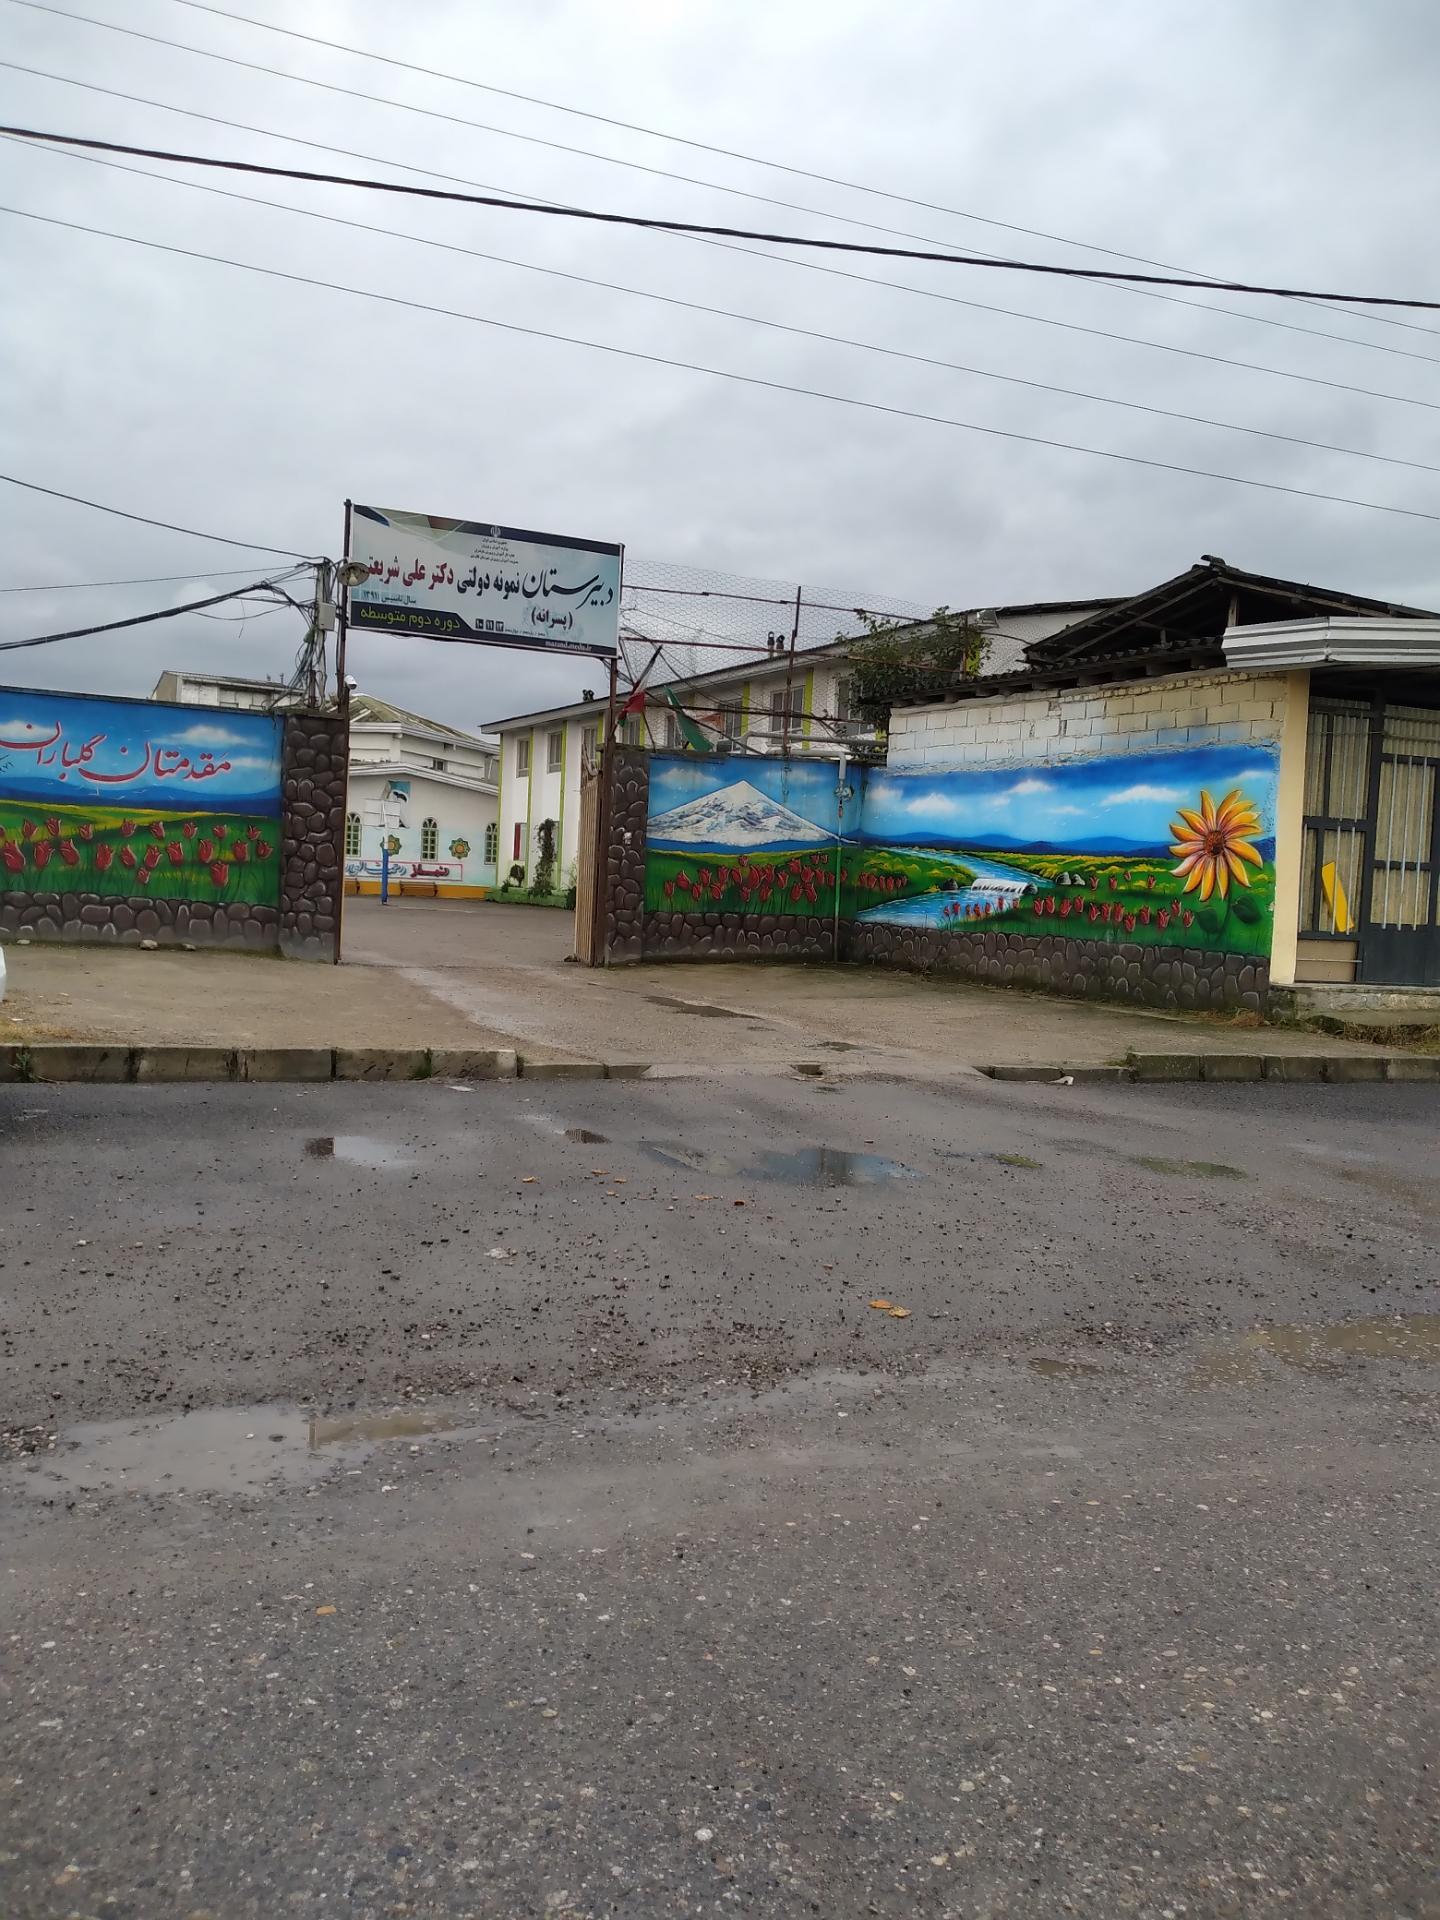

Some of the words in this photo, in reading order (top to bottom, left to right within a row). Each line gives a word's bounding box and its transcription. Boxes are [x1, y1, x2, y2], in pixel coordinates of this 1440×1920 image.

[367, 556, 399, 584] شریعت
[403, 558, 426, 587] علی
[428, 562, 454, 590] دکتر
[457, 566, 490, 596] دولتی
[493, 570, 520, 600] نمونه
[522, 568, 613, 610] دبیرستان
[360, 606, 406, 624] متوسطه
[408, 614, 432, 629] دوم
[434, 618, 461, 632] دوره
